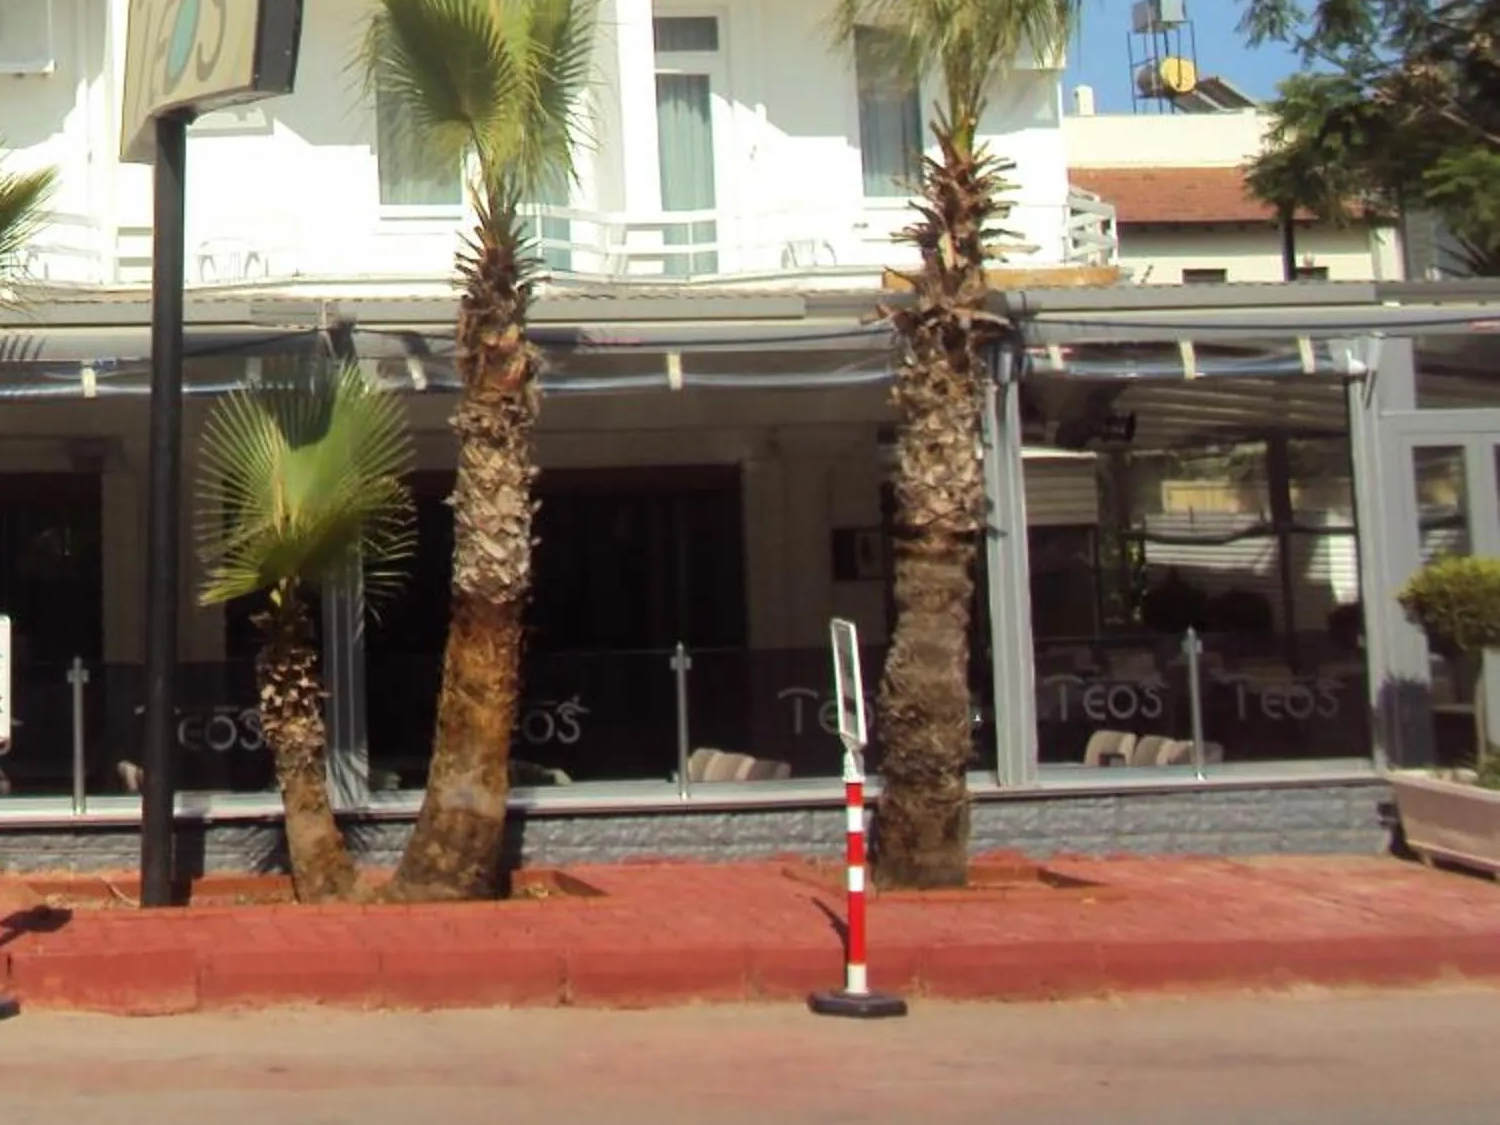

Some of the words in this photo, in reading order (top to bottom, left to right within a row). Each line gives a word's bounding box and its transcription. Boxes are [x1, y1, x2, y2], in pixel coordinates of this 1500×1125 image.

[777, 687, 875, 736] TE
[1042, 673, 1164, 722] TEOS
[1218, 672, 1340, 721] TEOS
